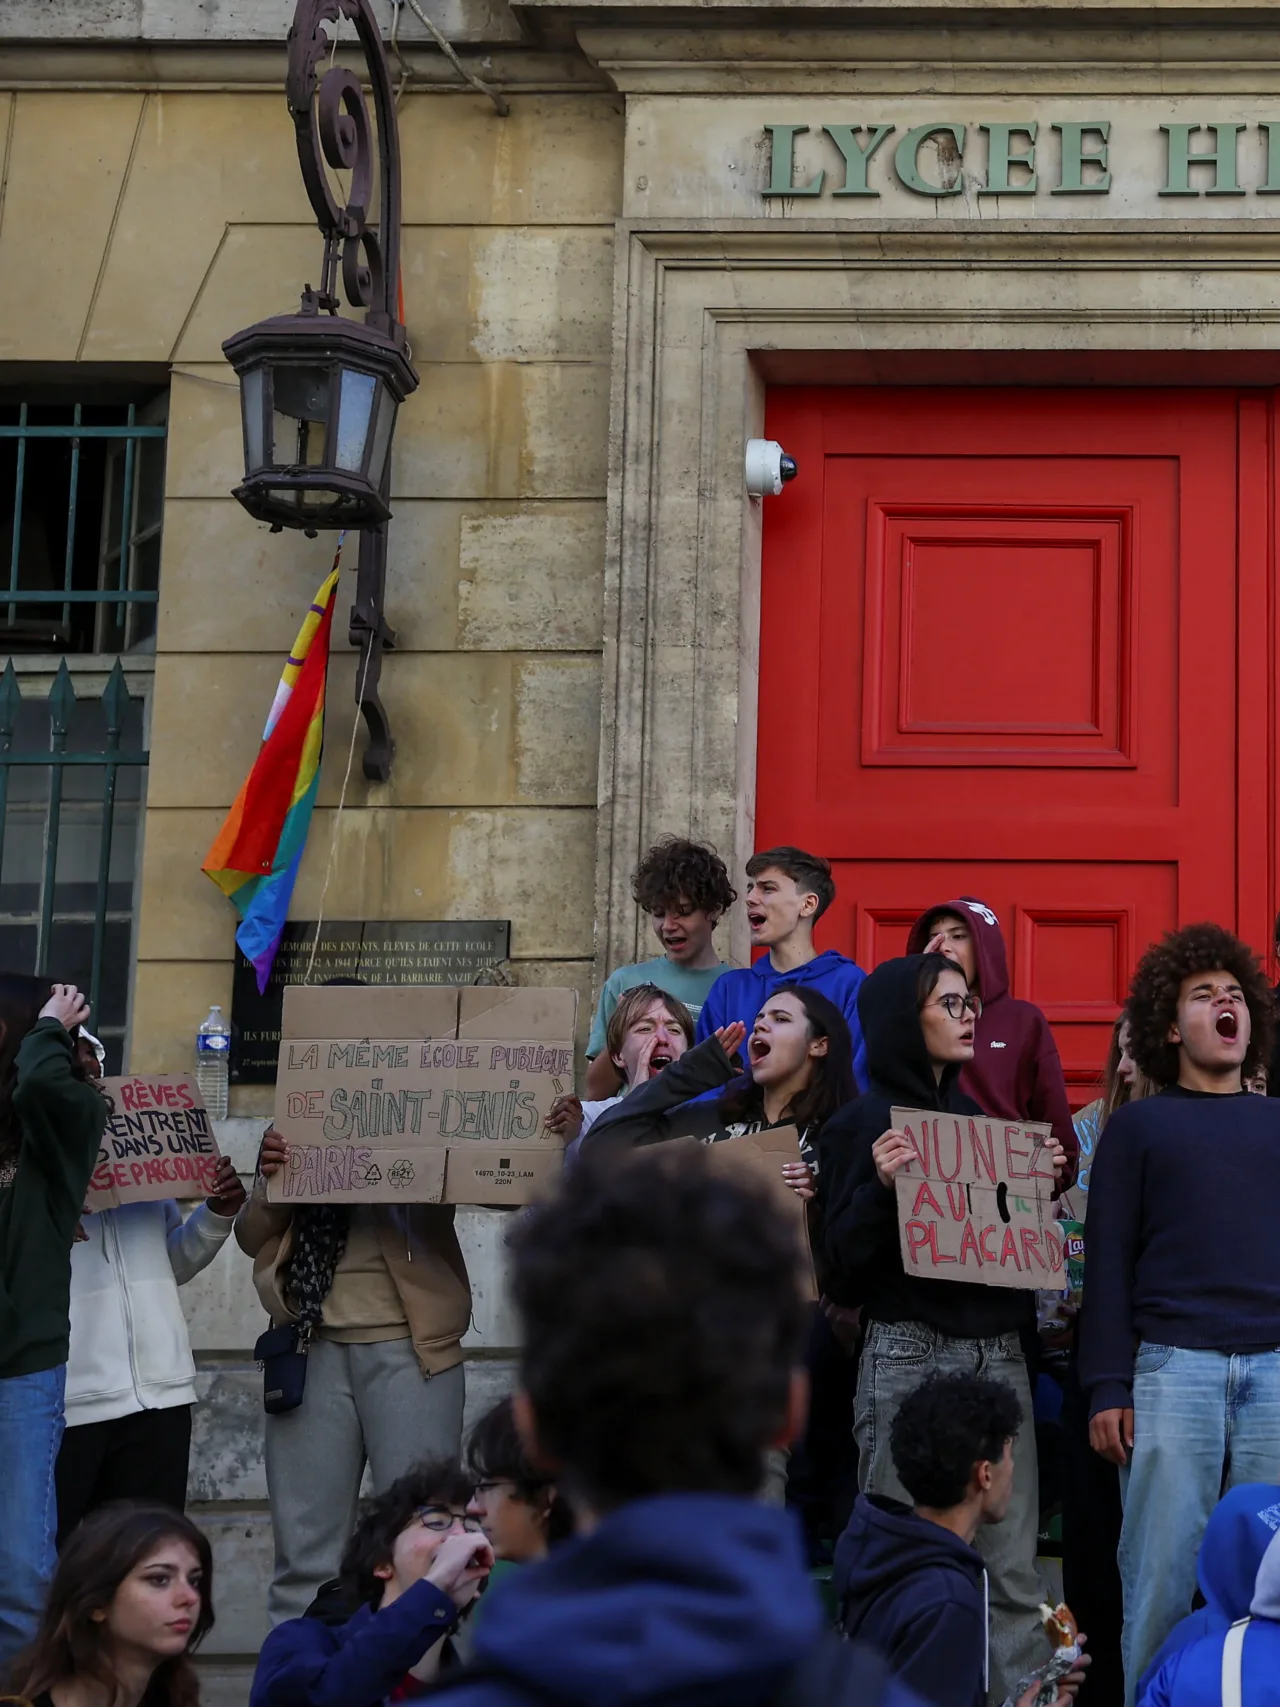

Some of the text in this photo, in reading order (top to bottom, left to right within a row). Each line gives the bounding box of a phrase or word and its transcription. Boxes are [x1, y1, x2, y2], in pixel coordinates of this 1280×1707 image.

[761, 121, 1111, 198] LYCEE
[321, 941, 337, 952] DES
[341, 941, 381, 953] ENFANTS,
[419, 942, 430, 951] DE
[354, 958, 382, 968] PARCE
[371, 974, 382, 983] DE
[386, 974, 397, 983] LA
[287, 1043, 319, 1070] LA
[327, 1037, 409, 1069] MÊME
[420, 1036, 480, 1069] ÉCOLE
[121, 1079, 195, 1111] RÊVES
[286, 1090, 325, 1119] DE
[111, 1134, 164, 1159] DANS
[166, 1133, 213, 1155] UNE
[903, 1119, 1053, 1186] NUNEZ
[282, 1146, 374, 1198] PARIS
[911, 1181, 966, 1222] AU
[905, 1219, 1064, 1274] PLACARD
